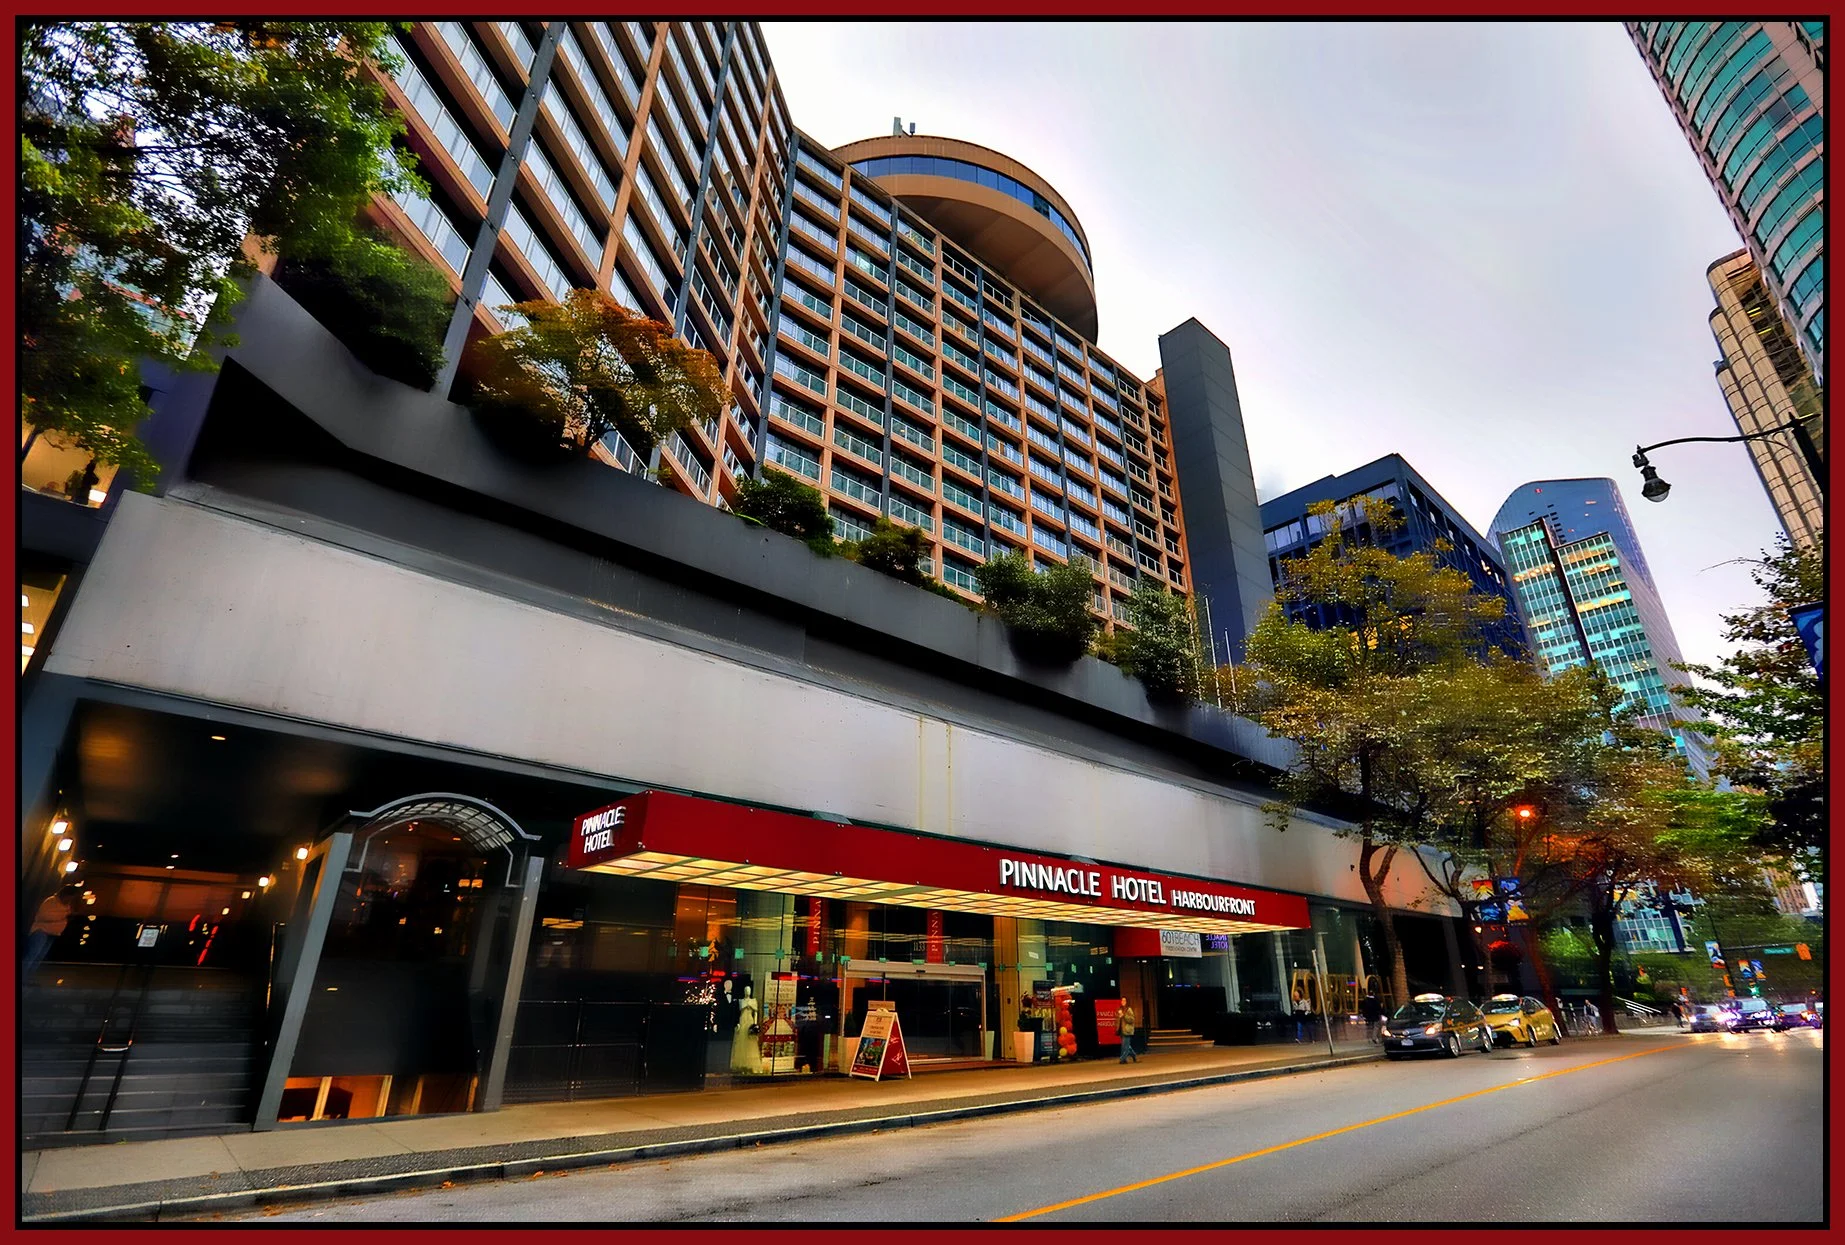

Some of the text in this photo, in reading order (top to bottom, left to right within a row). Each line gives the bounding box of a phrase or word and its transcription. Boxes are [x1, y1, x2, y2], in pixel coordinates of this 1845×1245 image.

[581, 806, 626, 836] PINNACLE
[584, 830, 614, 853] HOTEL
[1000, 859, 1256, 916] PINNACLE HOTEL HARBOURFRONT
